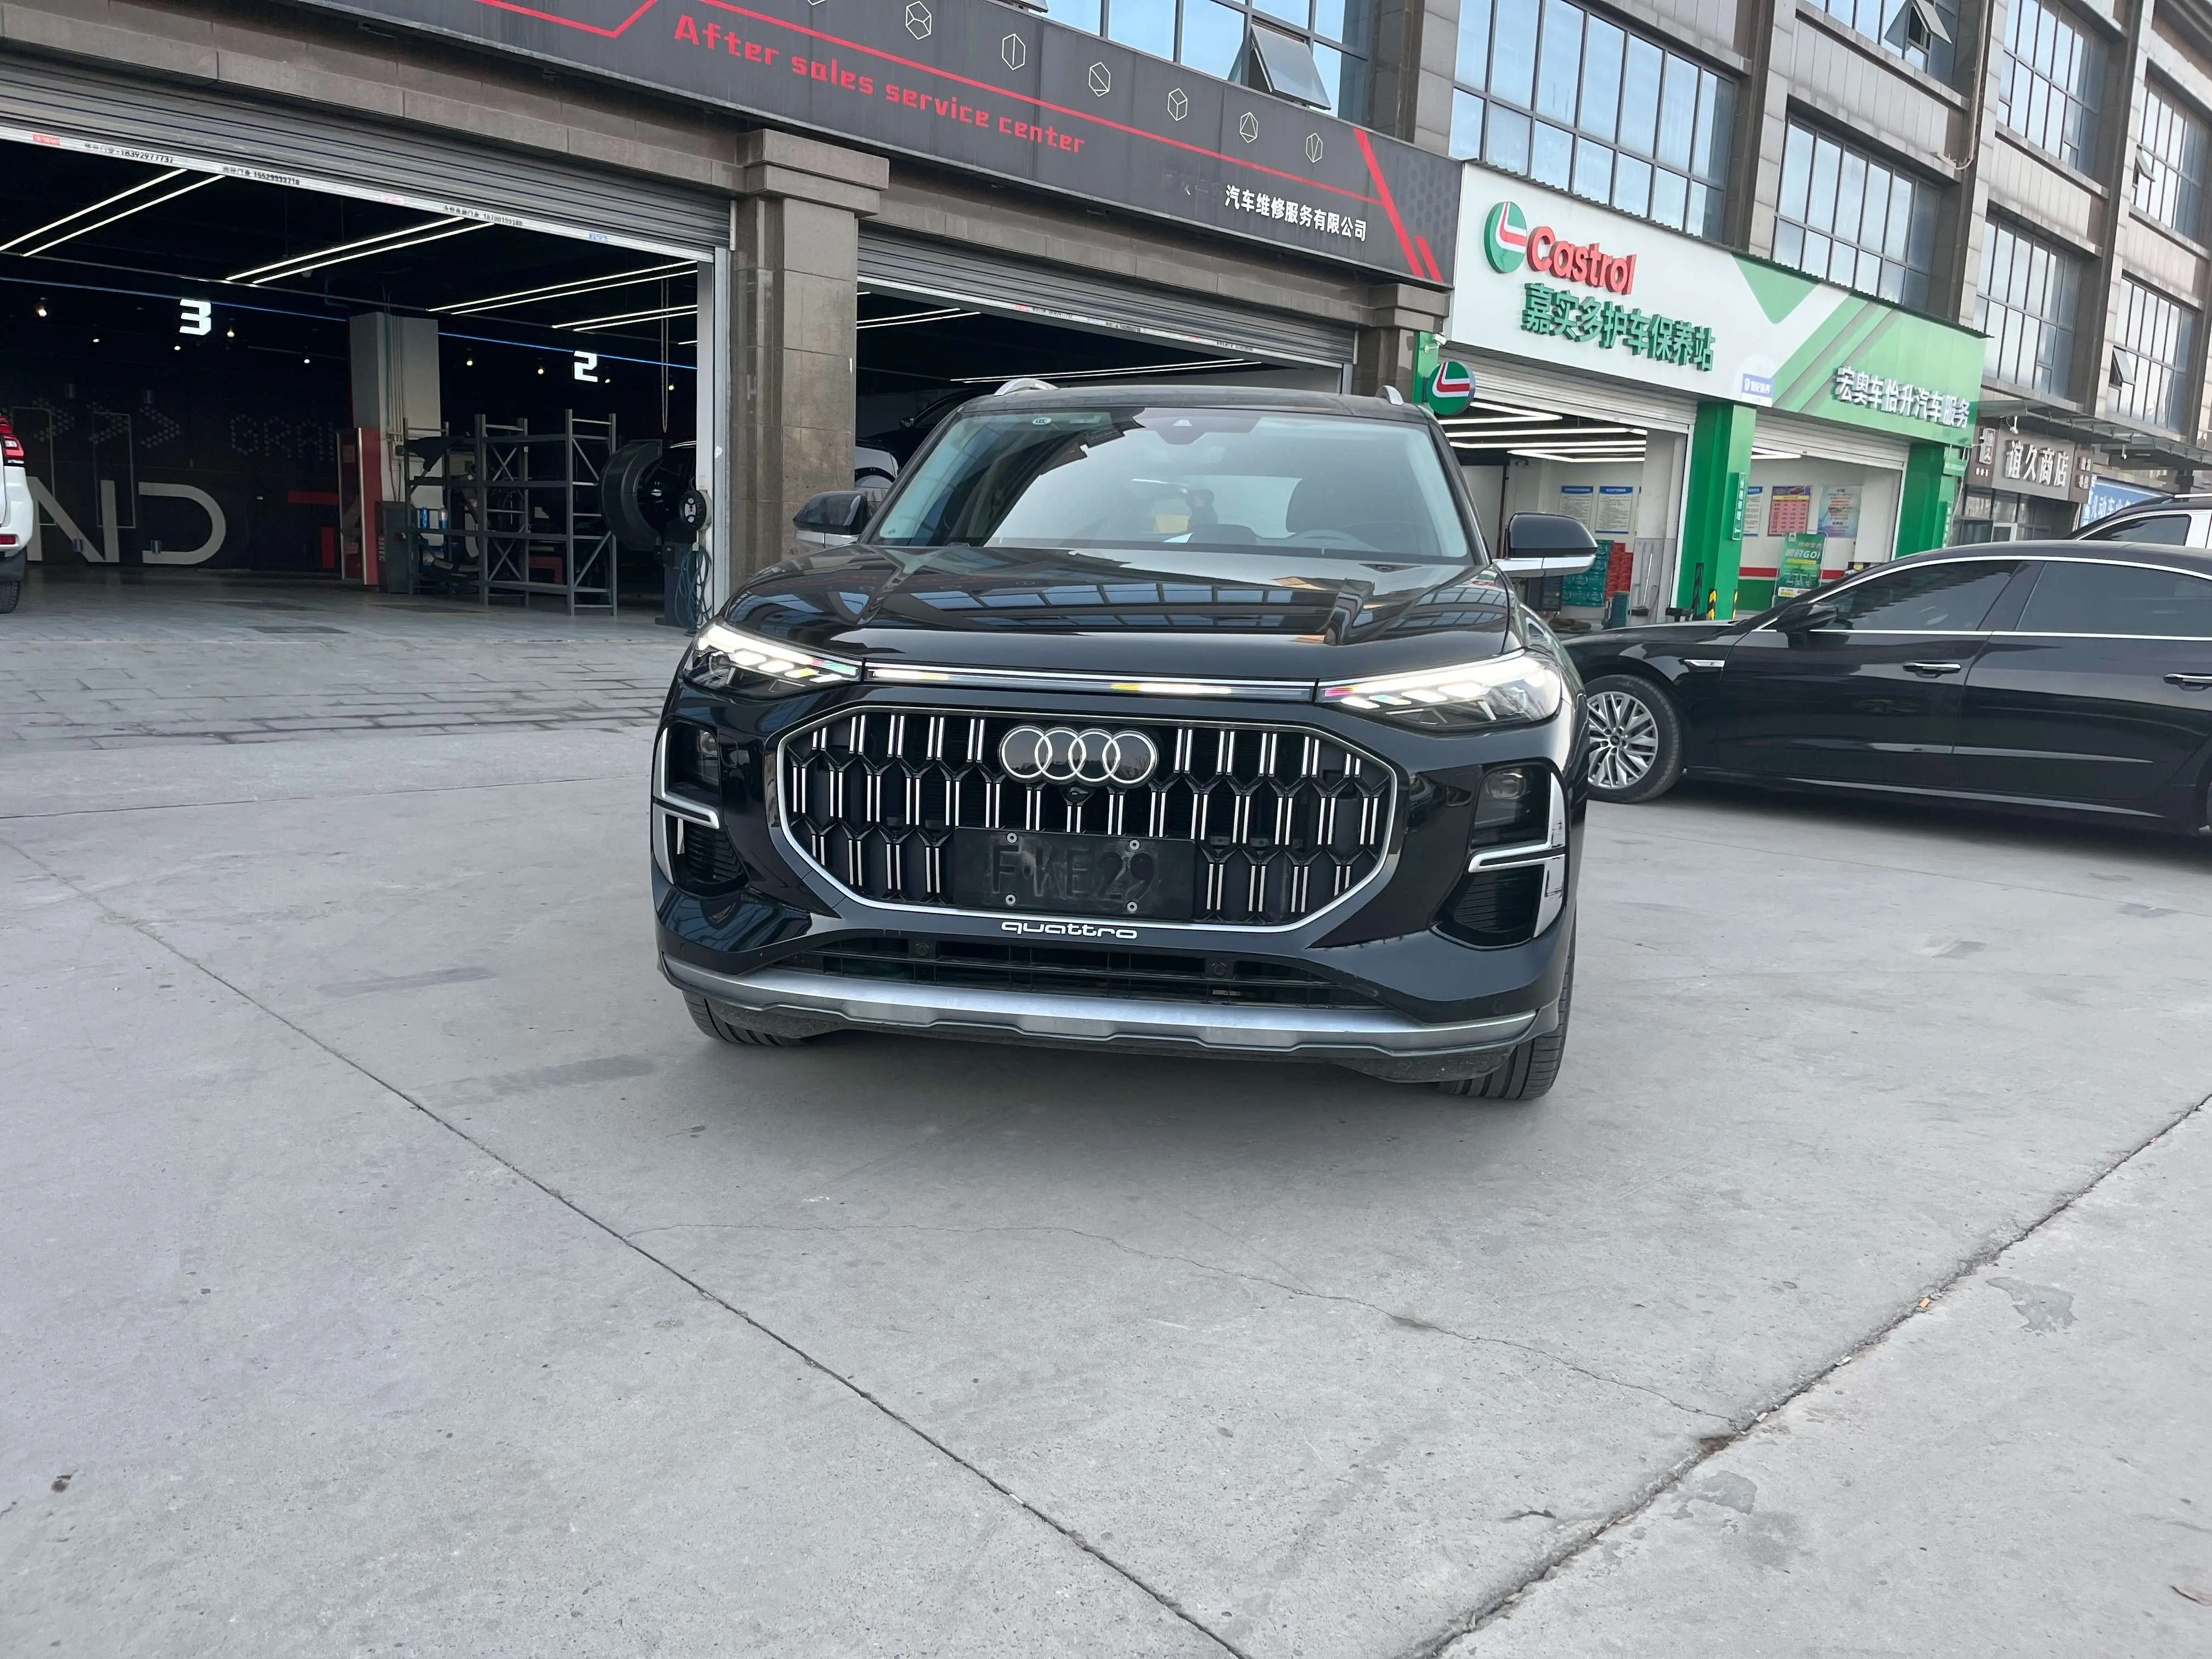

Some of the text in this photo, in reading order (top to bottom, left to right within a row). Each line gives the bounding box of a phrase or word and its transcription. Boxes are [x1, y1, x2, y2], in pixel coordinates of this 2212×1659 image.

[674, 14, 1085, 153] After sales service center
[1224, 184, 1368, 242] 汽车维修服务有限公司
[1526, 225, 1638, 295] Castrol
[179, 298, 212, 336] 3
[1520, 283, 1716, 371] 嘉实多护车保养站
[574, 350, 598, 382] 2
[1834, 366, 1971, 428] 宏奥车怡升汽车服务
[2005, 439, 2069, 487] 谊久商店
[1001, 921, 1137, 939] quattro
